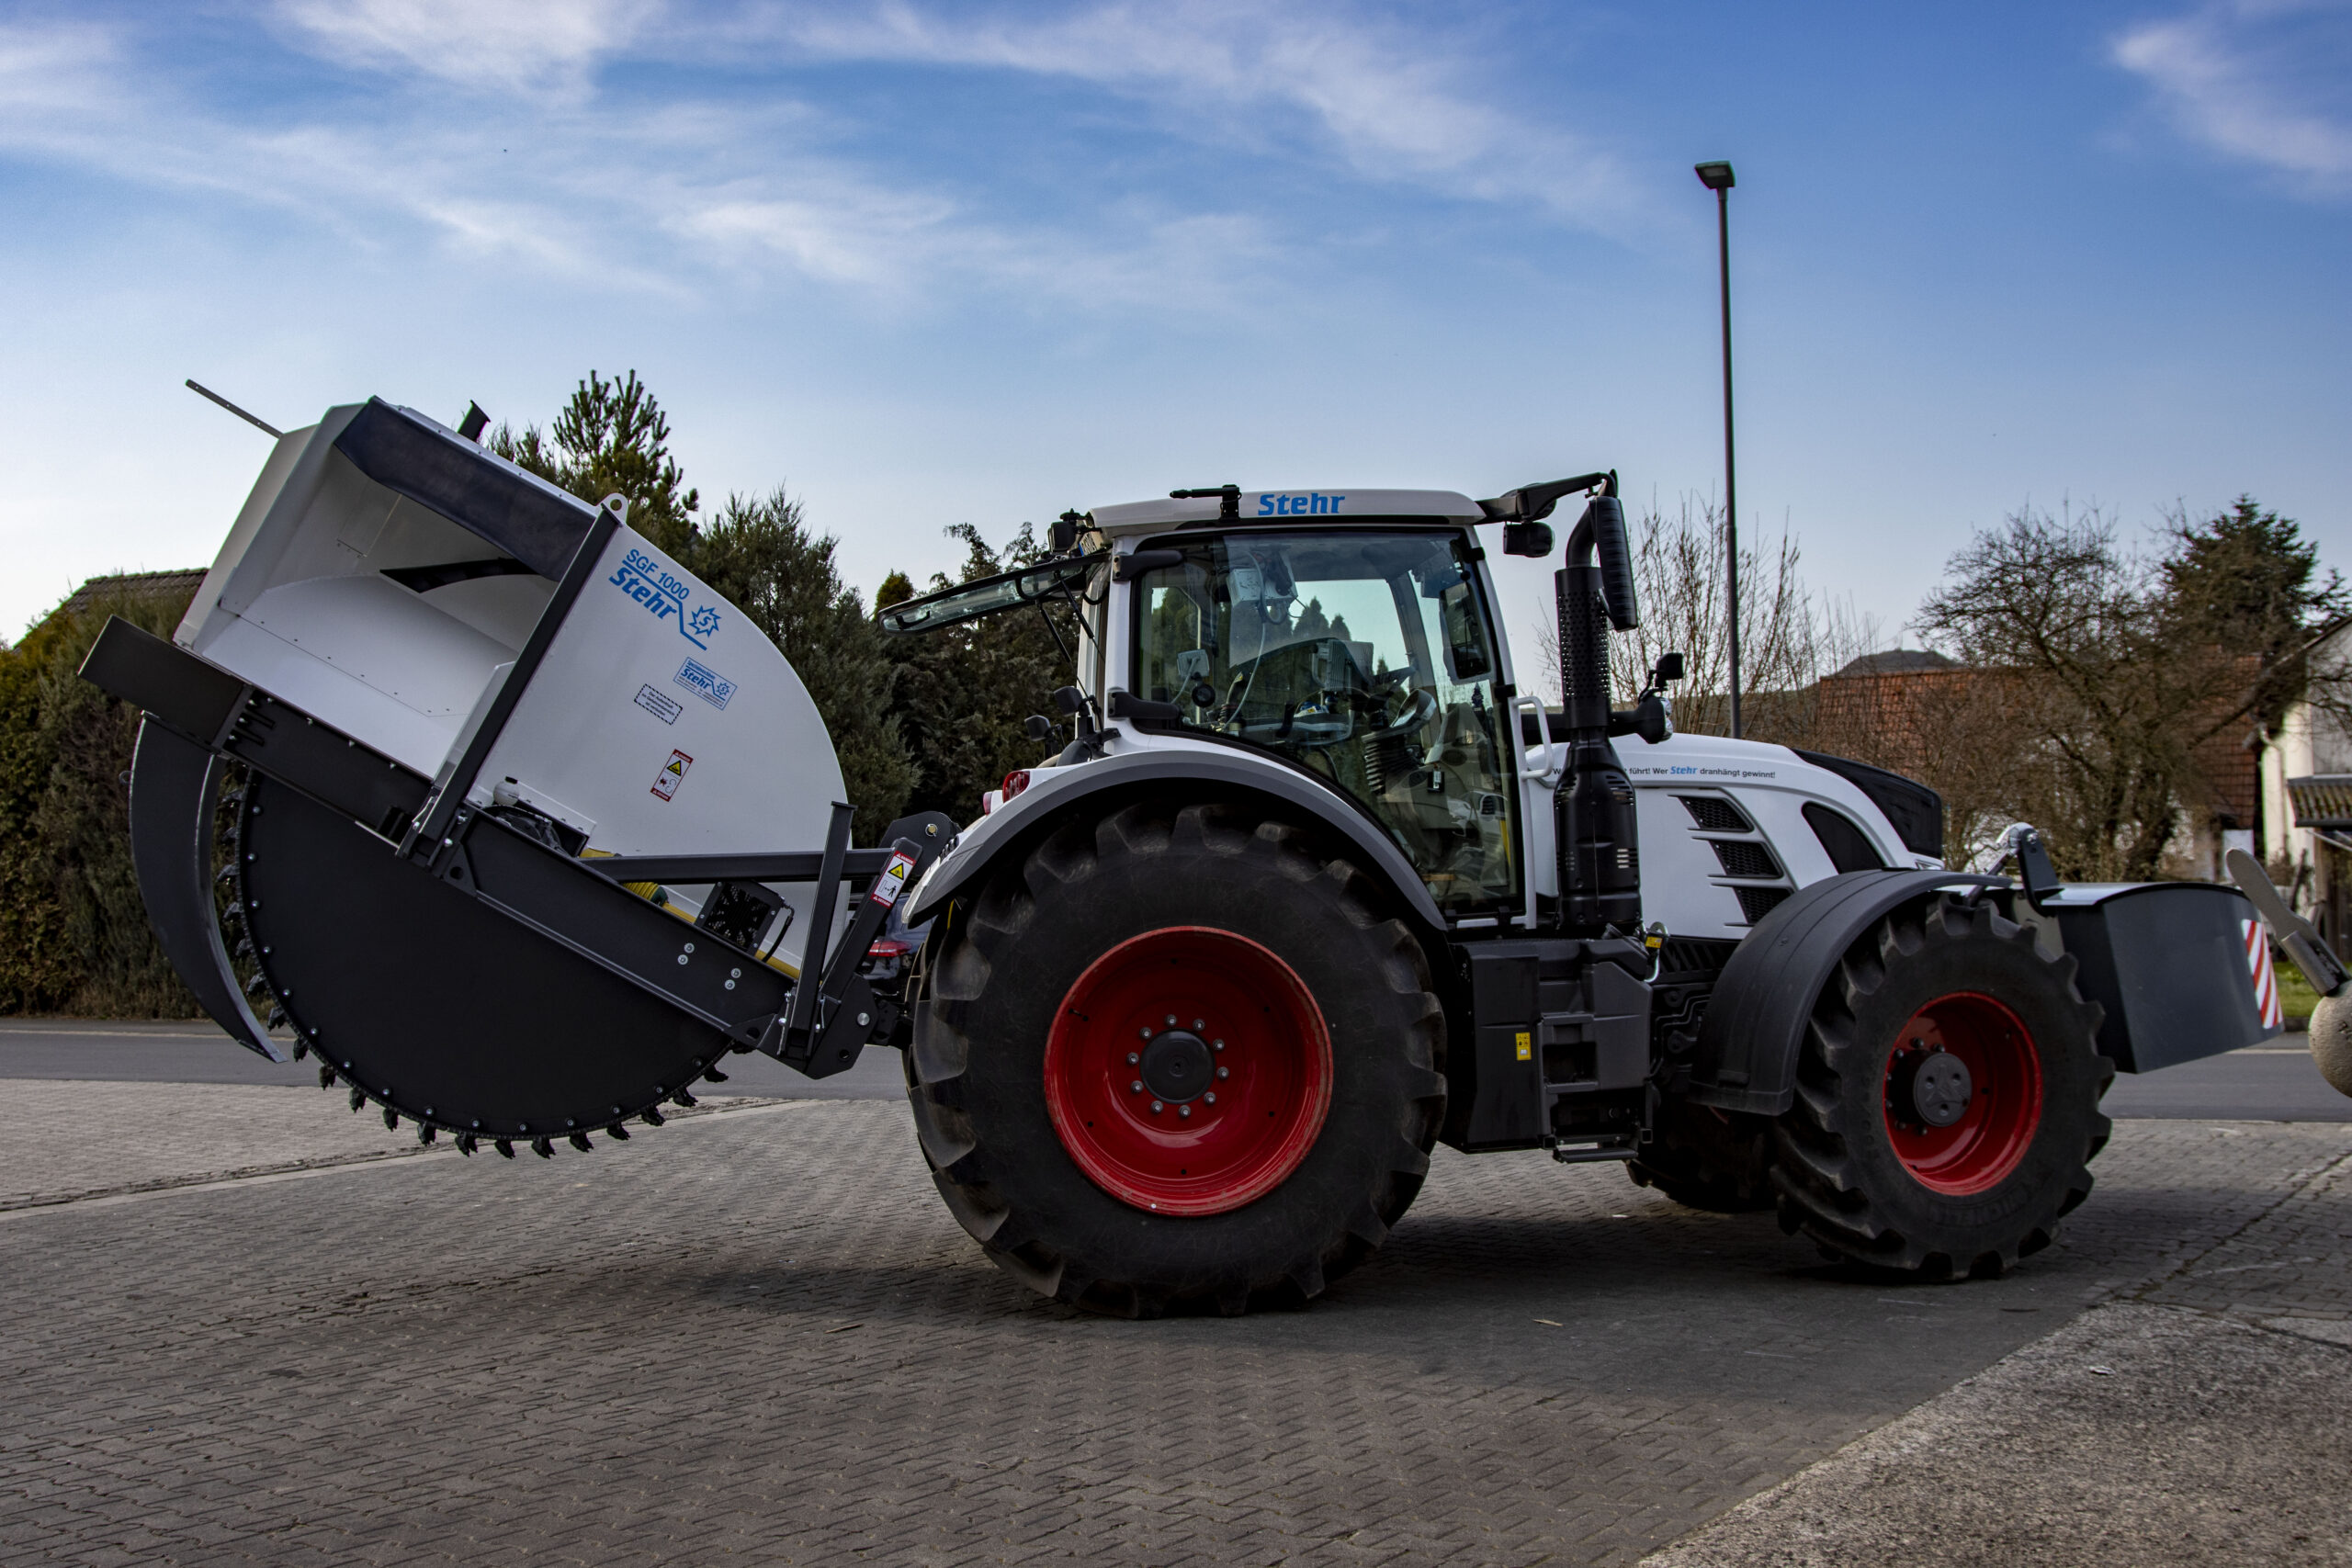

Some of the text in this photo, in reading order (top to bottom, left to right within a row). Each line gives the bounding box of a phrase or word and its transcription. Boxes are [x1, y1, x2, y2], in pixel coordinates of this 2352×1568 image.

[1257, 492, 1346, 516] Stehr
[627, 548, 690, 600] SGF 1000
[608, 567, 677, 620] Stehr
[680, 668, 711, 689] Stehr
[1670, 765, 1698, 775] Stehr
[1700, 768, 1741, 778] dranhängt
[1742, 770, 1776, 779] gewinnt!
